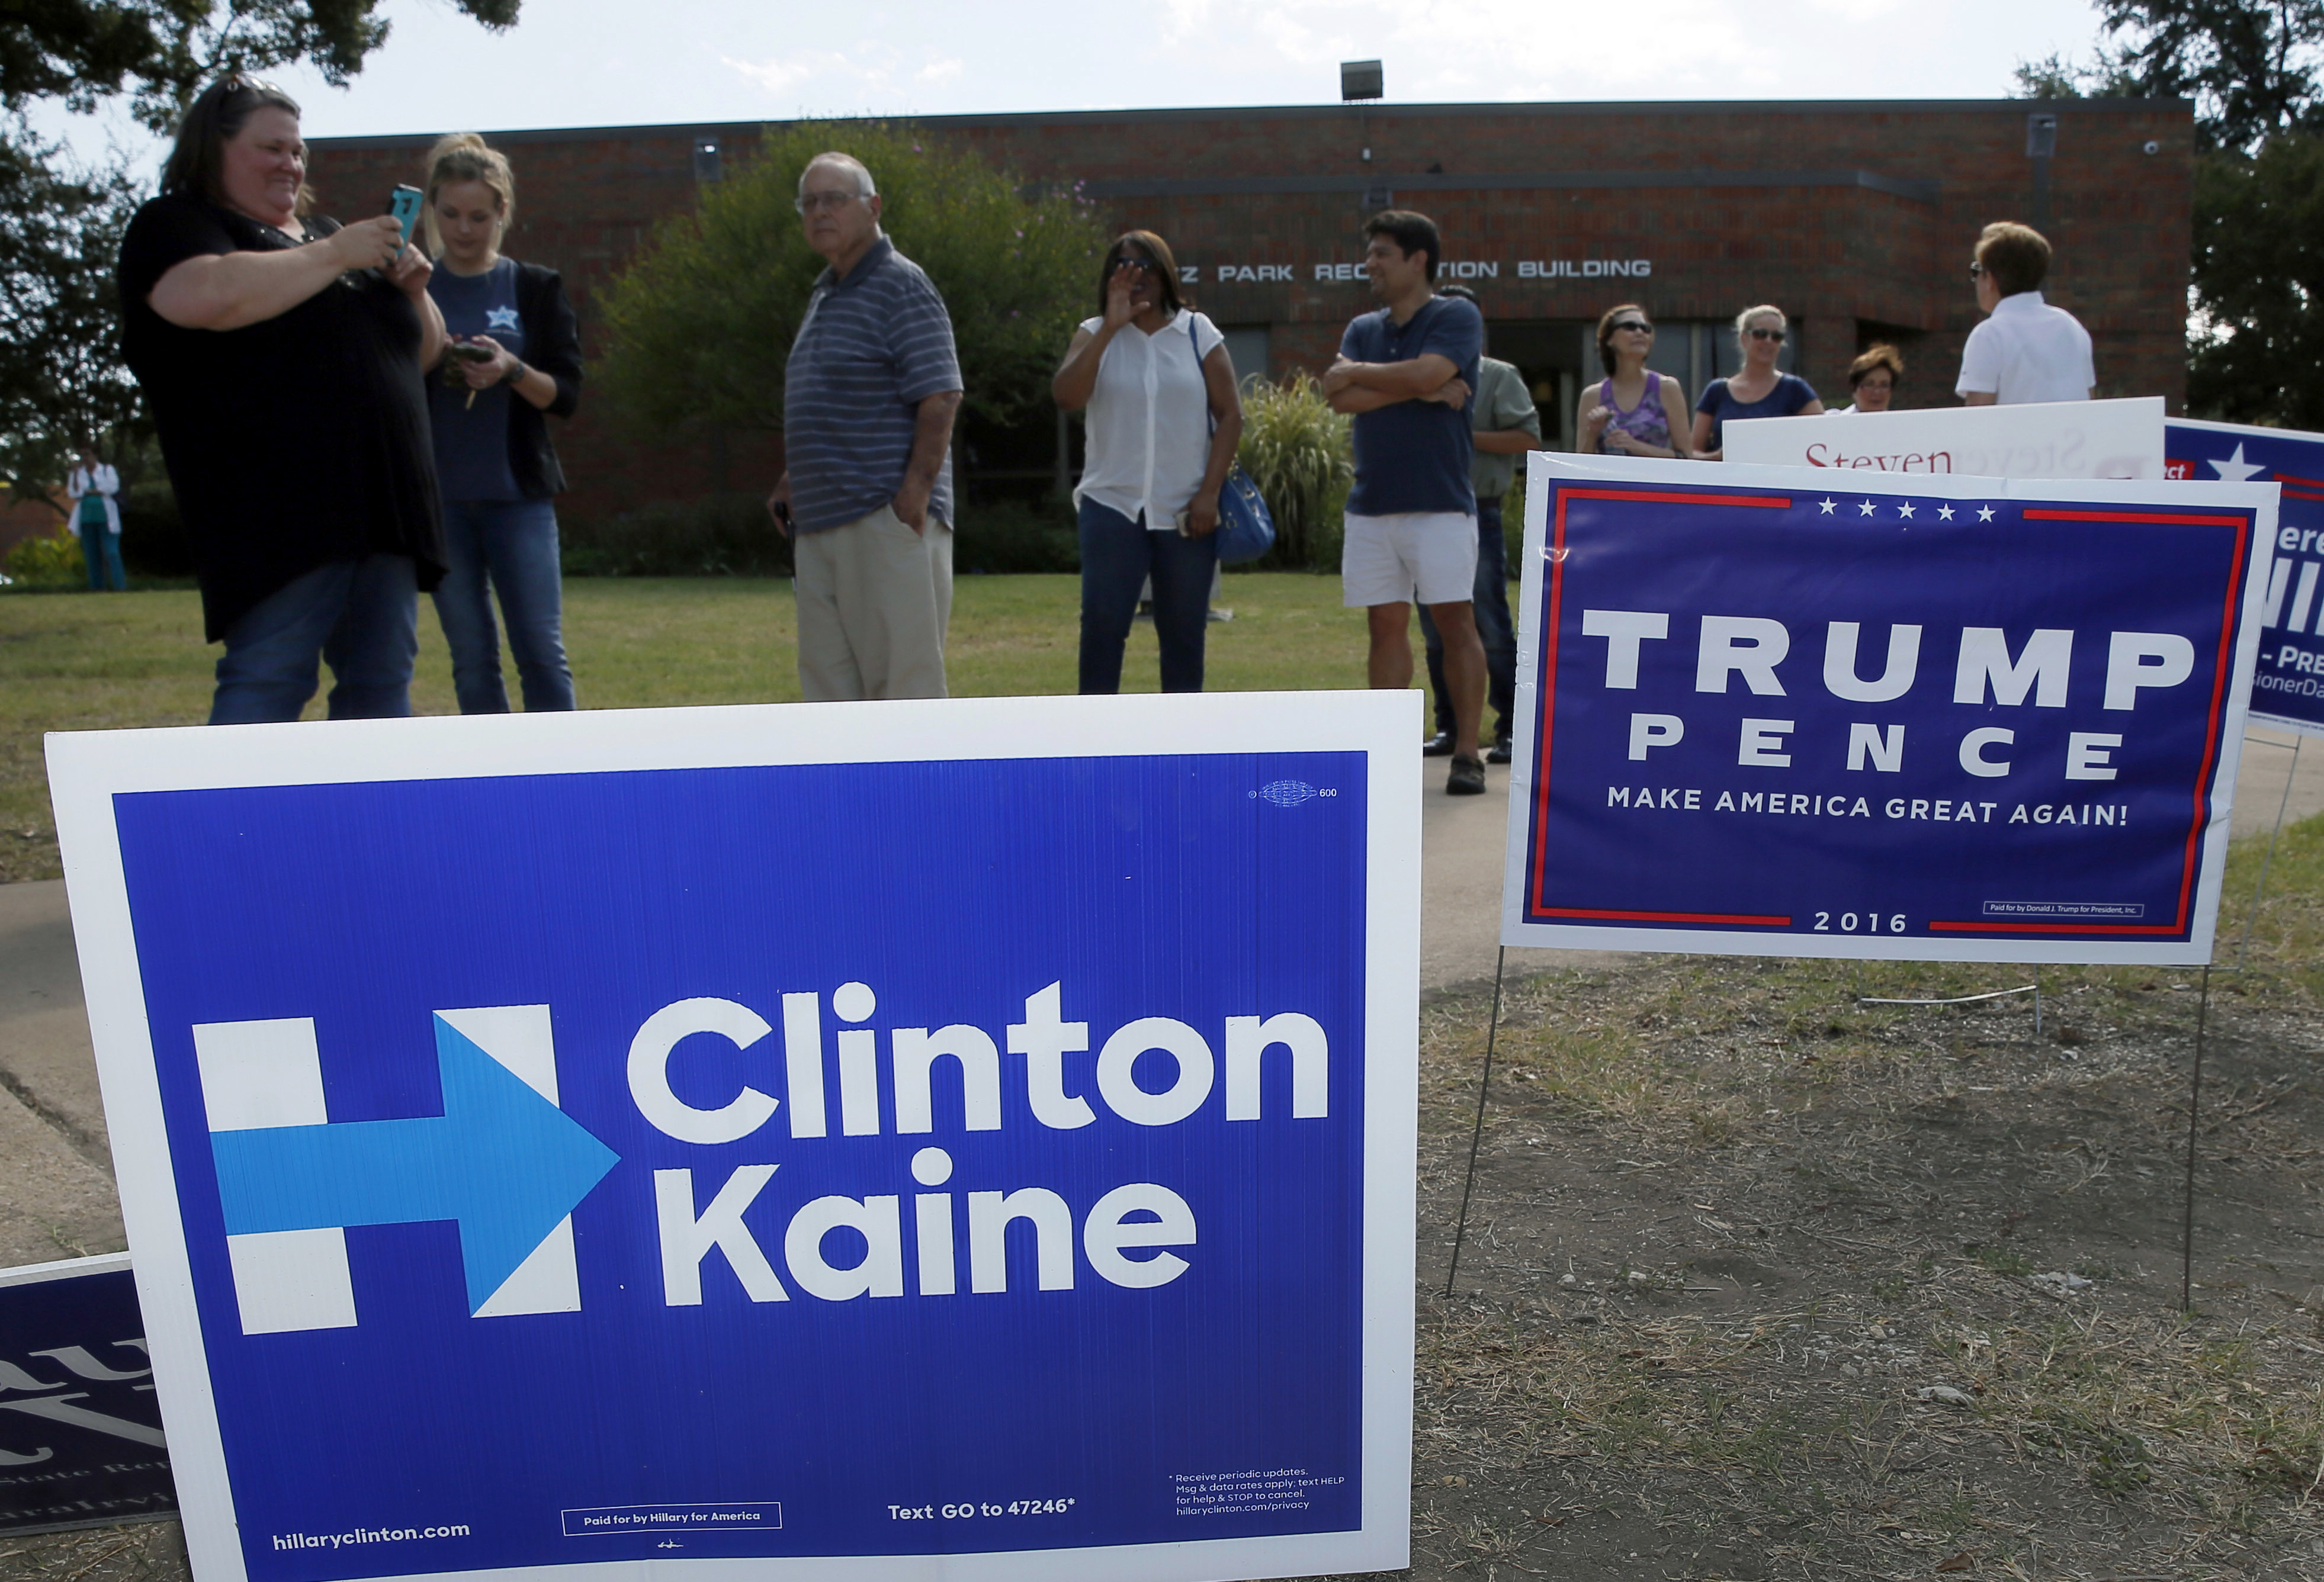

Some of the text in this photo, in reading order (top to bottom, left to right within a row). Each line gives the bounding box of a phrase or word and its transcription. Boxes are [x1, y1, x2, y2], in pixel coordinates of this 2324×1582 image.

[1218, 265, 1293, 282] PARK
[1517, 259, 1651, 278] BUILDING
[1806, 442, 1951, 474] Steven
[1582, 609, 2194, 710] TRUMP
[1628, 713, 2123, 780] PENCE
[1320, 789, 1337, 797] 600
[1607, 786, 2127, 826] MAKE AMERICA GREAT AGAIN!
[1814, 912, 1906, 932] 2016
[627, 981, 1328, 1145] Clinton
[653, 1147, 1197, 1307] Kaine
[1176, 1468, 1308, 1483] Receive periodic updates.
[1176, 1485, 1196, 1494] Msg
[1209, 1483, 1234, 1491] data
[1236, 1481, 1263, 1490] rates
[1298, 1478, 1318, 1487] text
[1321, 1477, 1344, 1485] HELP
[1176, 1496, 1190, 1504] for
[1193, 1494, 1215, 1504] help
[1227, 1493, 1253, 1501] STOP
[1268, 1490, 1305, 1499] cancel.
[584, 1510, 760, 1526] Paid for by Hillary for America
[888, 1504, 933, 1519] Text
[942, 1503, 975, 1519] GO
[981, 1502, 1003, 1516] to
[1176, 1500, 1309, 1516] hillaryclinton.com/privacy
[272, 1525, 470, 1550] hillaryclinton.com
